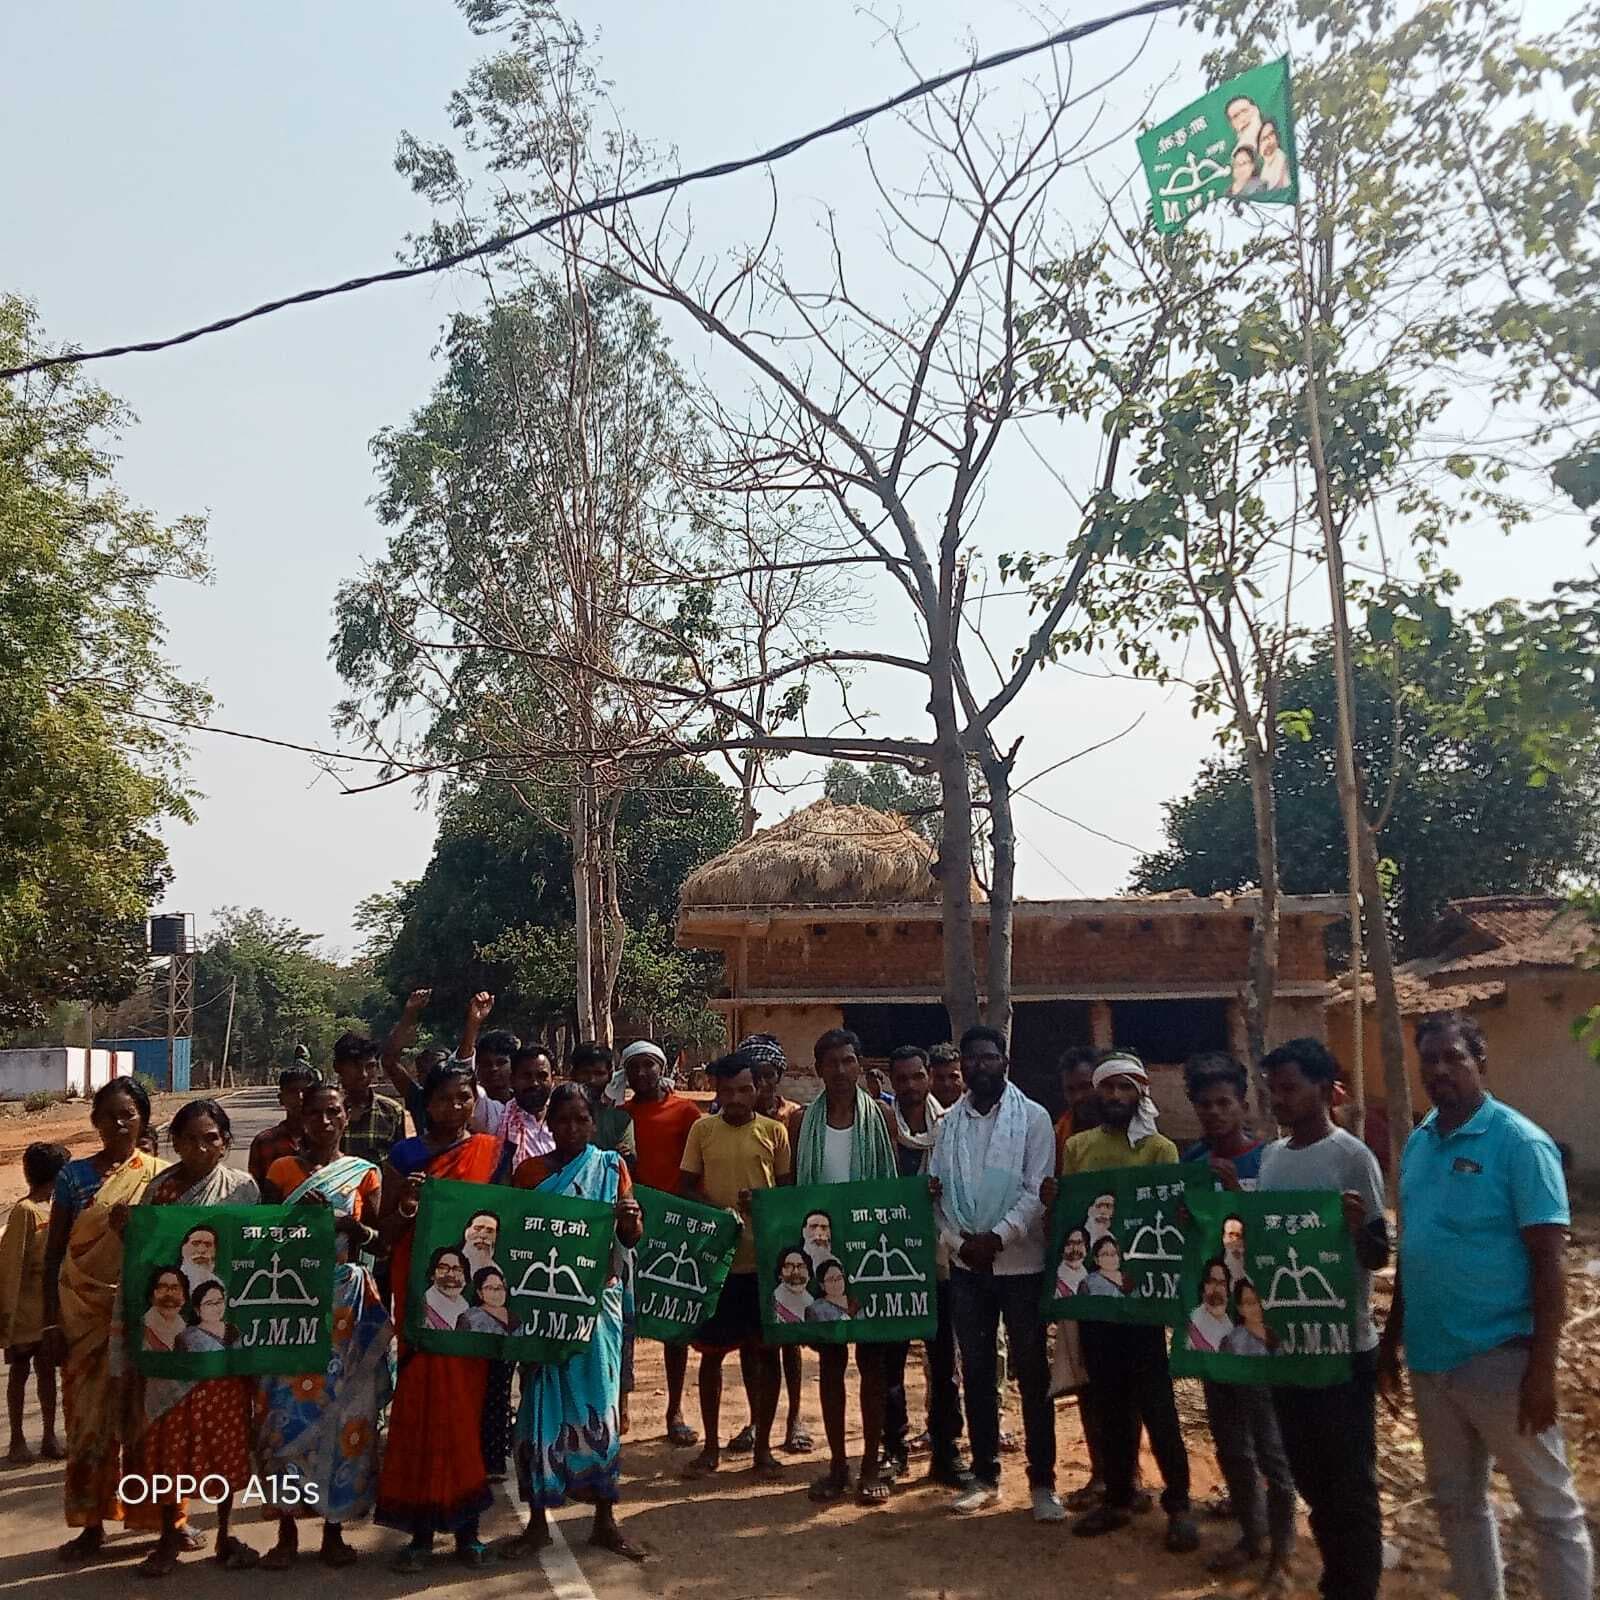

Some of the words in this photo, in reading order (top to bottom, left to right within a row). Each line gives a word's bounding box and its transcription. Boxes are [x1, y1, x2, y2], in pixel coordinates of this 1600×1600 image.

[641, 1291, 703, 1324] J.M.M
[865, 1291, 929, 1318] J.M.M
[243, 1317, 320, 1347] J.M.M
[525, 1309, 597, 1343] J.M.M
